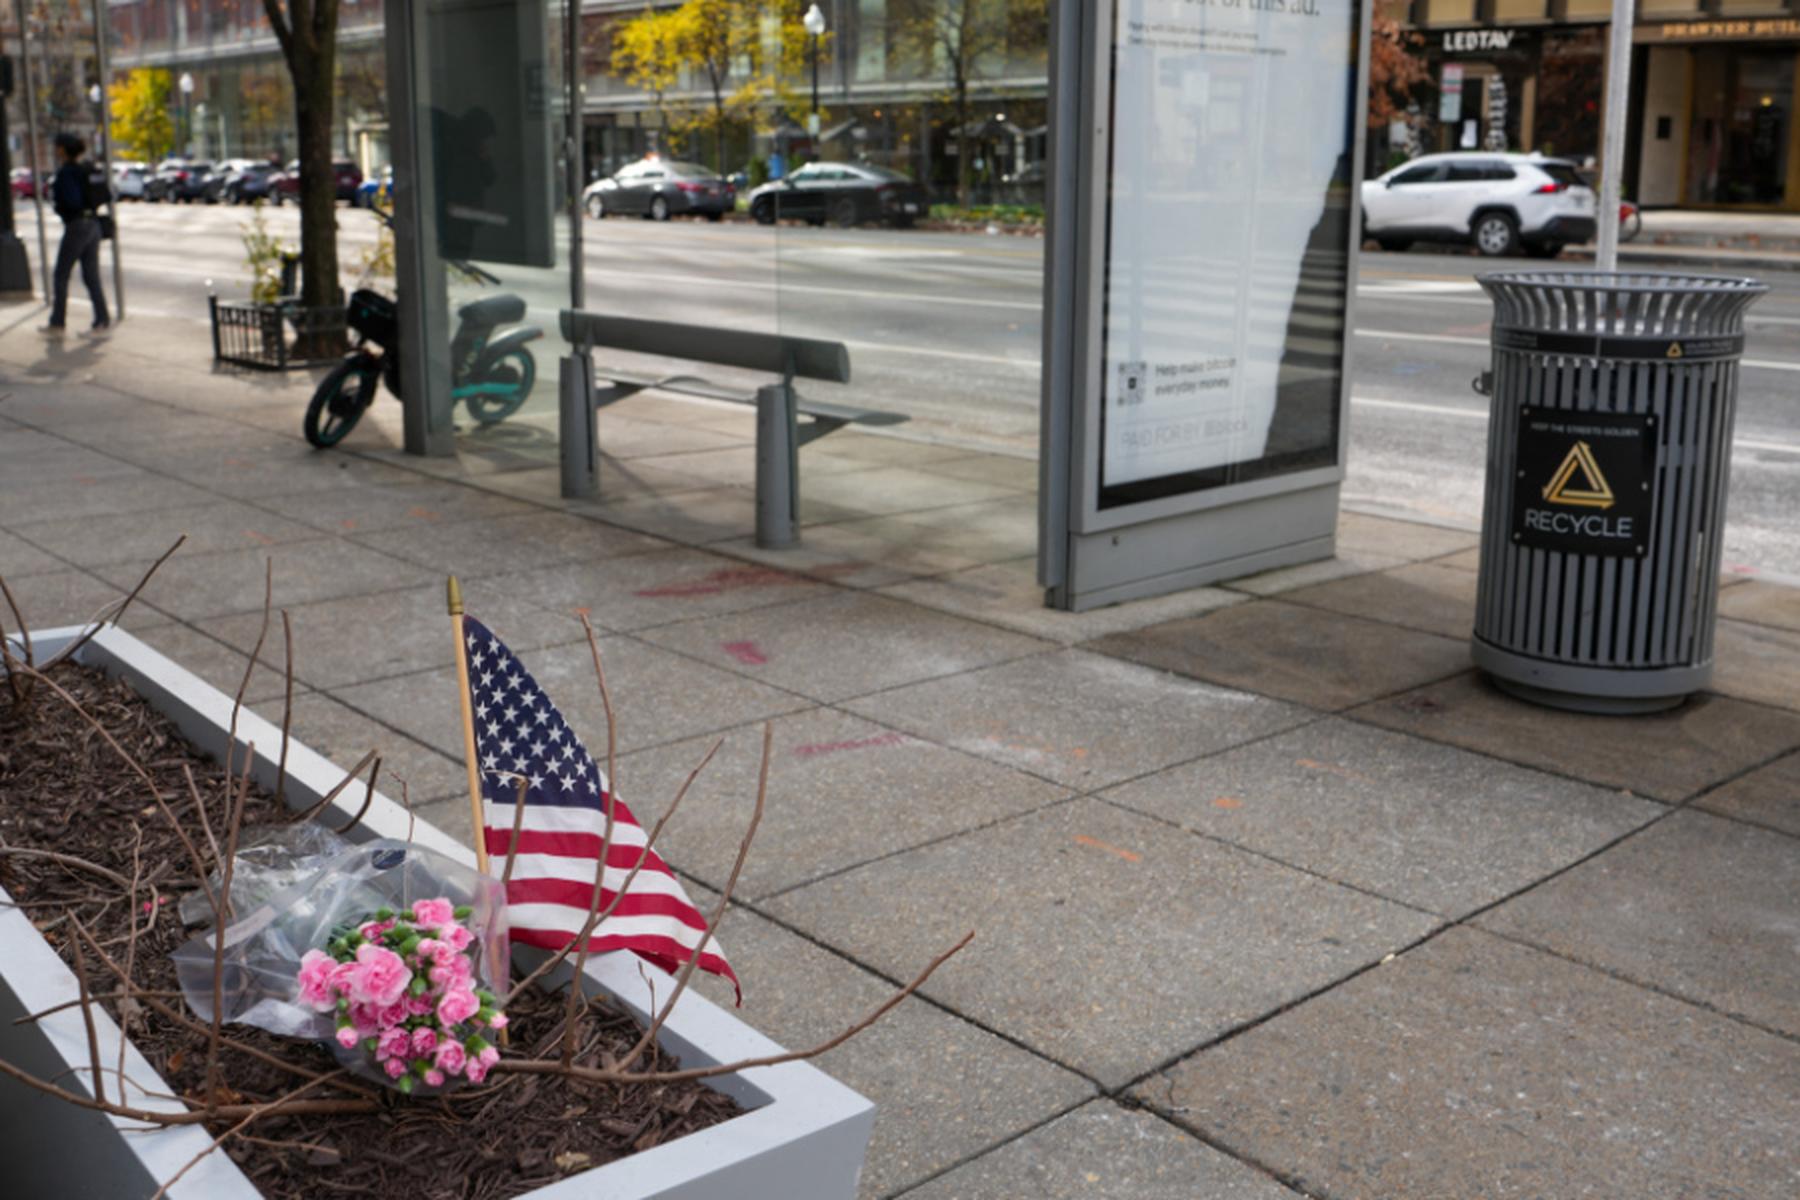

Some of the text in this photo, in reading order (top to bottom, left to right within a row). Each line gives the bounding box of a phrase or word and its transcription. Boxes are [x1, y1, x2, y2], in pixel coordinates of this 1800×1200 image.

[1155, 377, 1229, 396] everyday money
[1524, 508, 1633, 538] RECYCLE
